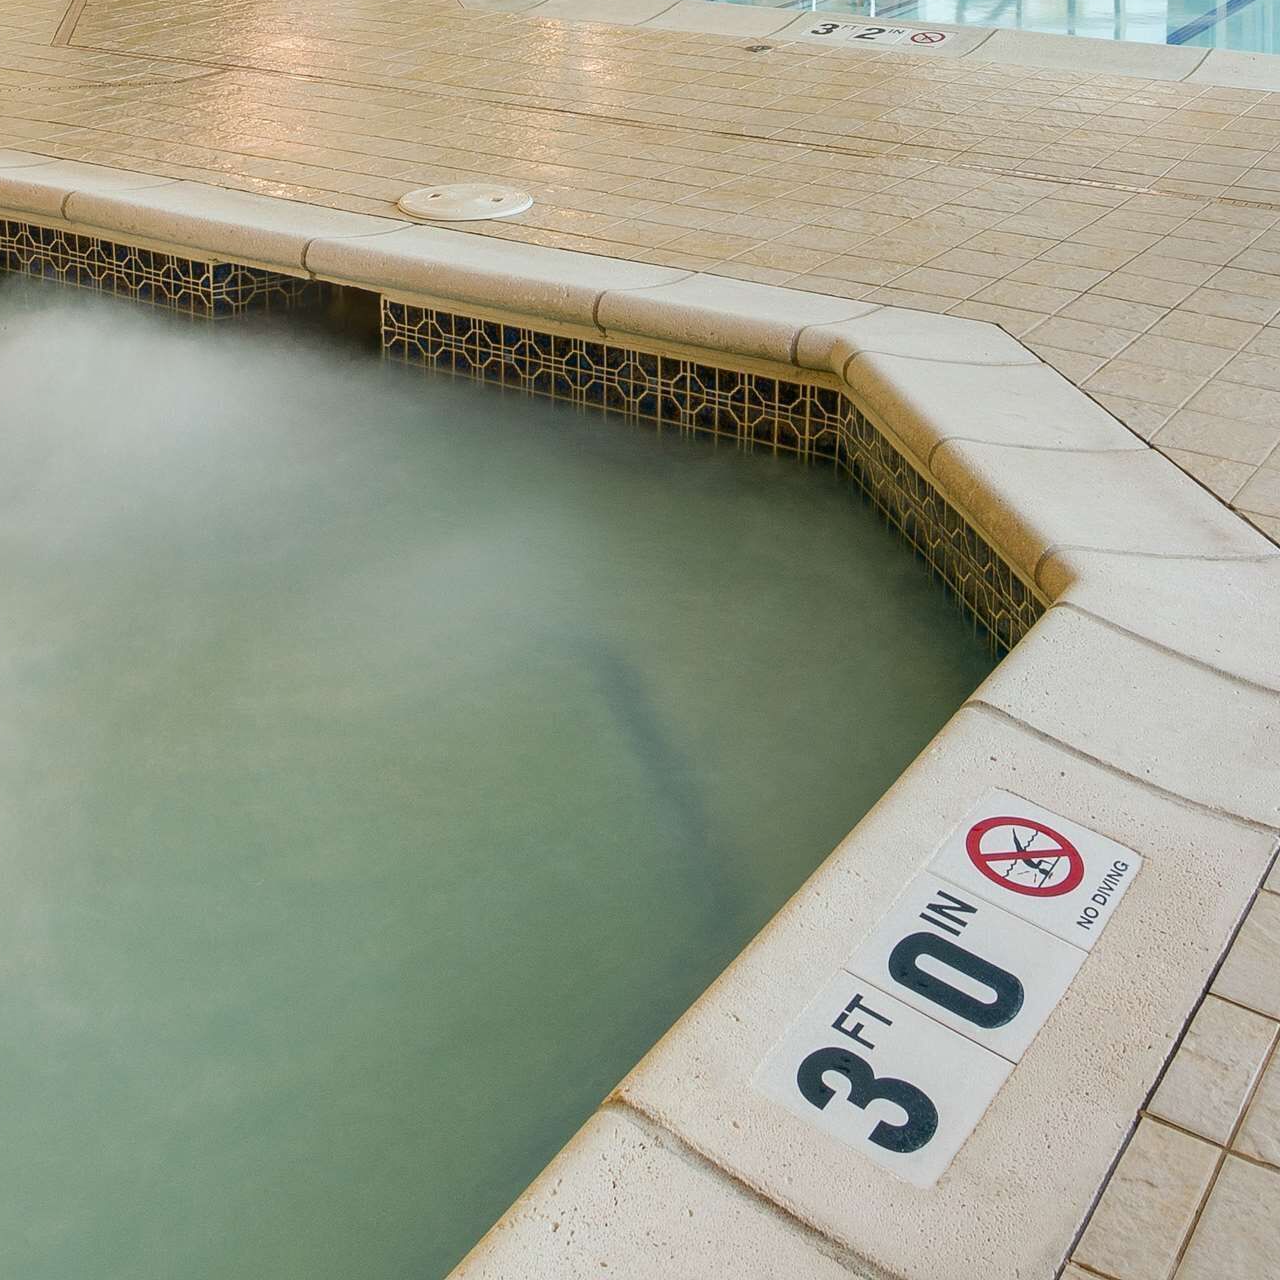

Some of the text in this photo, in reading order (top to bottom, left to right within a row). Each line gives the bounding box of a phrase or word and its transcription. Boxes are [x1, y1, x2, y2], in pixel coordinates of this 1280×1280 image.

[811, 23, 840, 35] 3
[853, 27, 886, 40] 2
[1076, 858, 1129, 931] NO DIVING
[796, 889, 1025, 1154] 3 FT 0 IN
